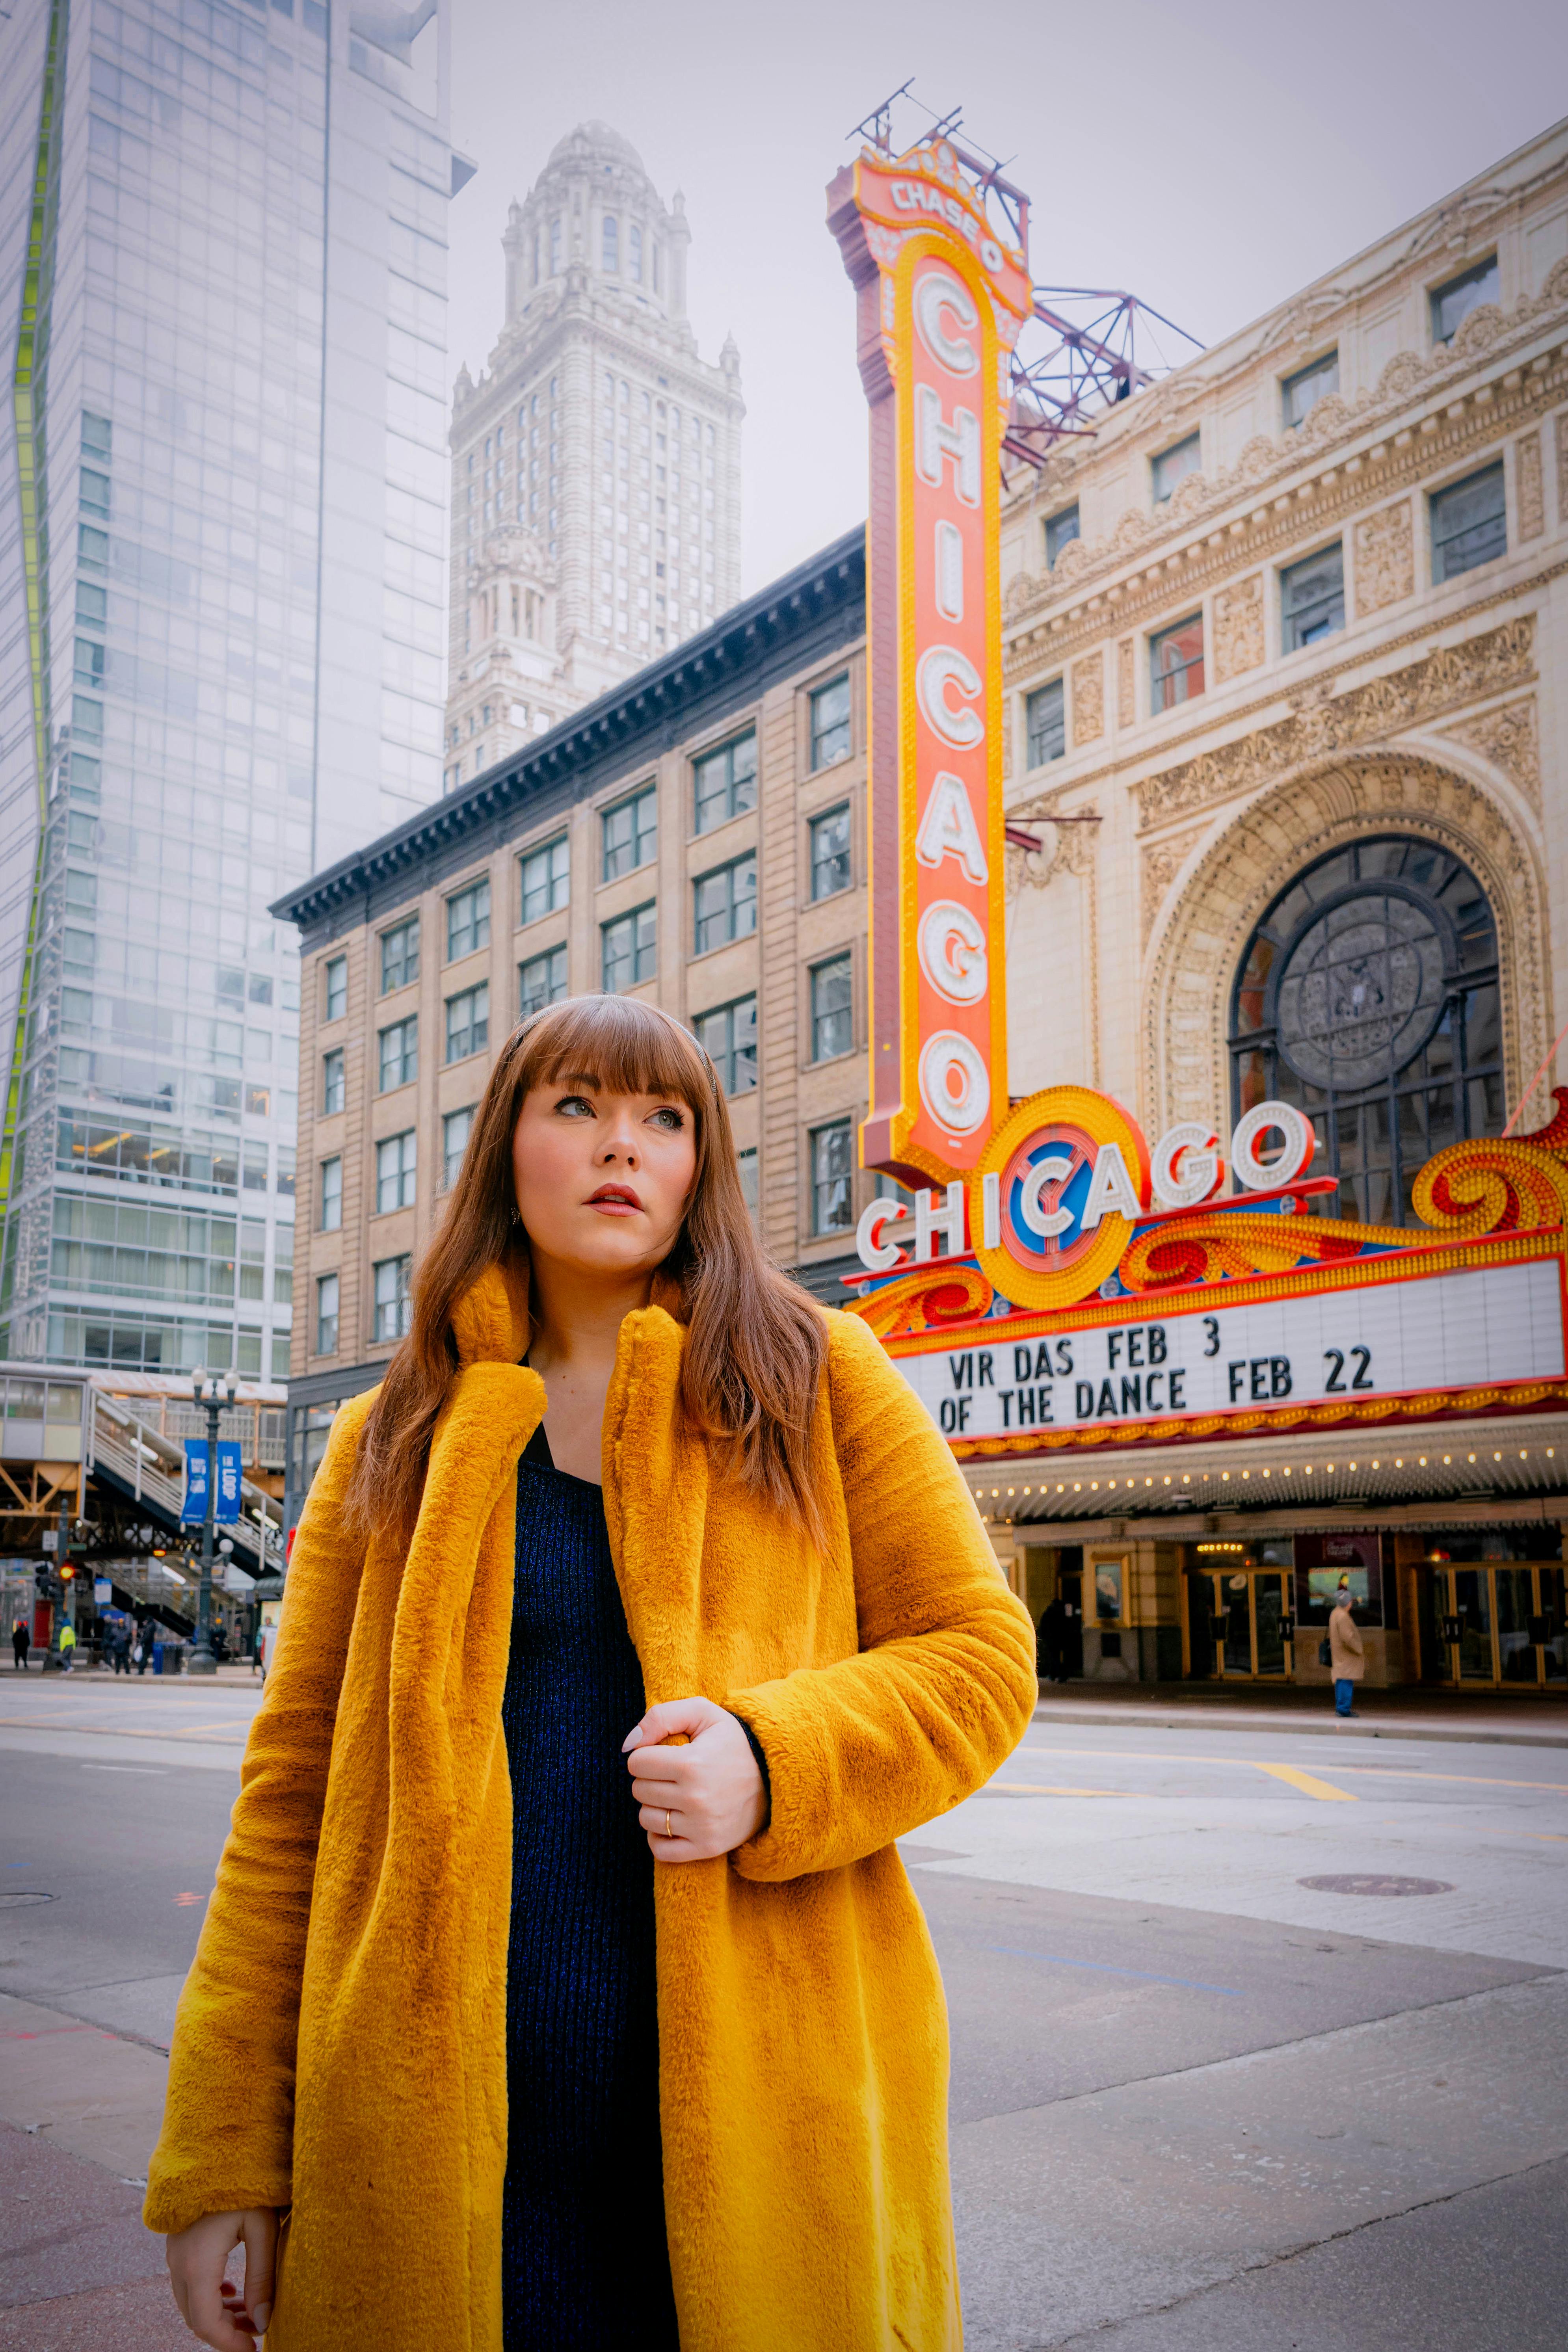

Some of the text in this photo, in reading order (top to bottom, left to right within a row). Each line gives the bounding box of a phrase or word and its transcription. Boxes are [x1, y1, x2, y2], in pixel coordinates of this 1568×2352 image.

[890, 181, 980, 244] CHASE
[912, 271, 991, 1137] CHICAGO
[856, 1100, 1311, 1271] CHICAGO
[940, 1344, 1374, 1433] OF THE DANCE FEB 22
[949, 1316, 1220, 1390] VIR DAS FEB 3
[223, 1469, 236, 1500] LOOP
